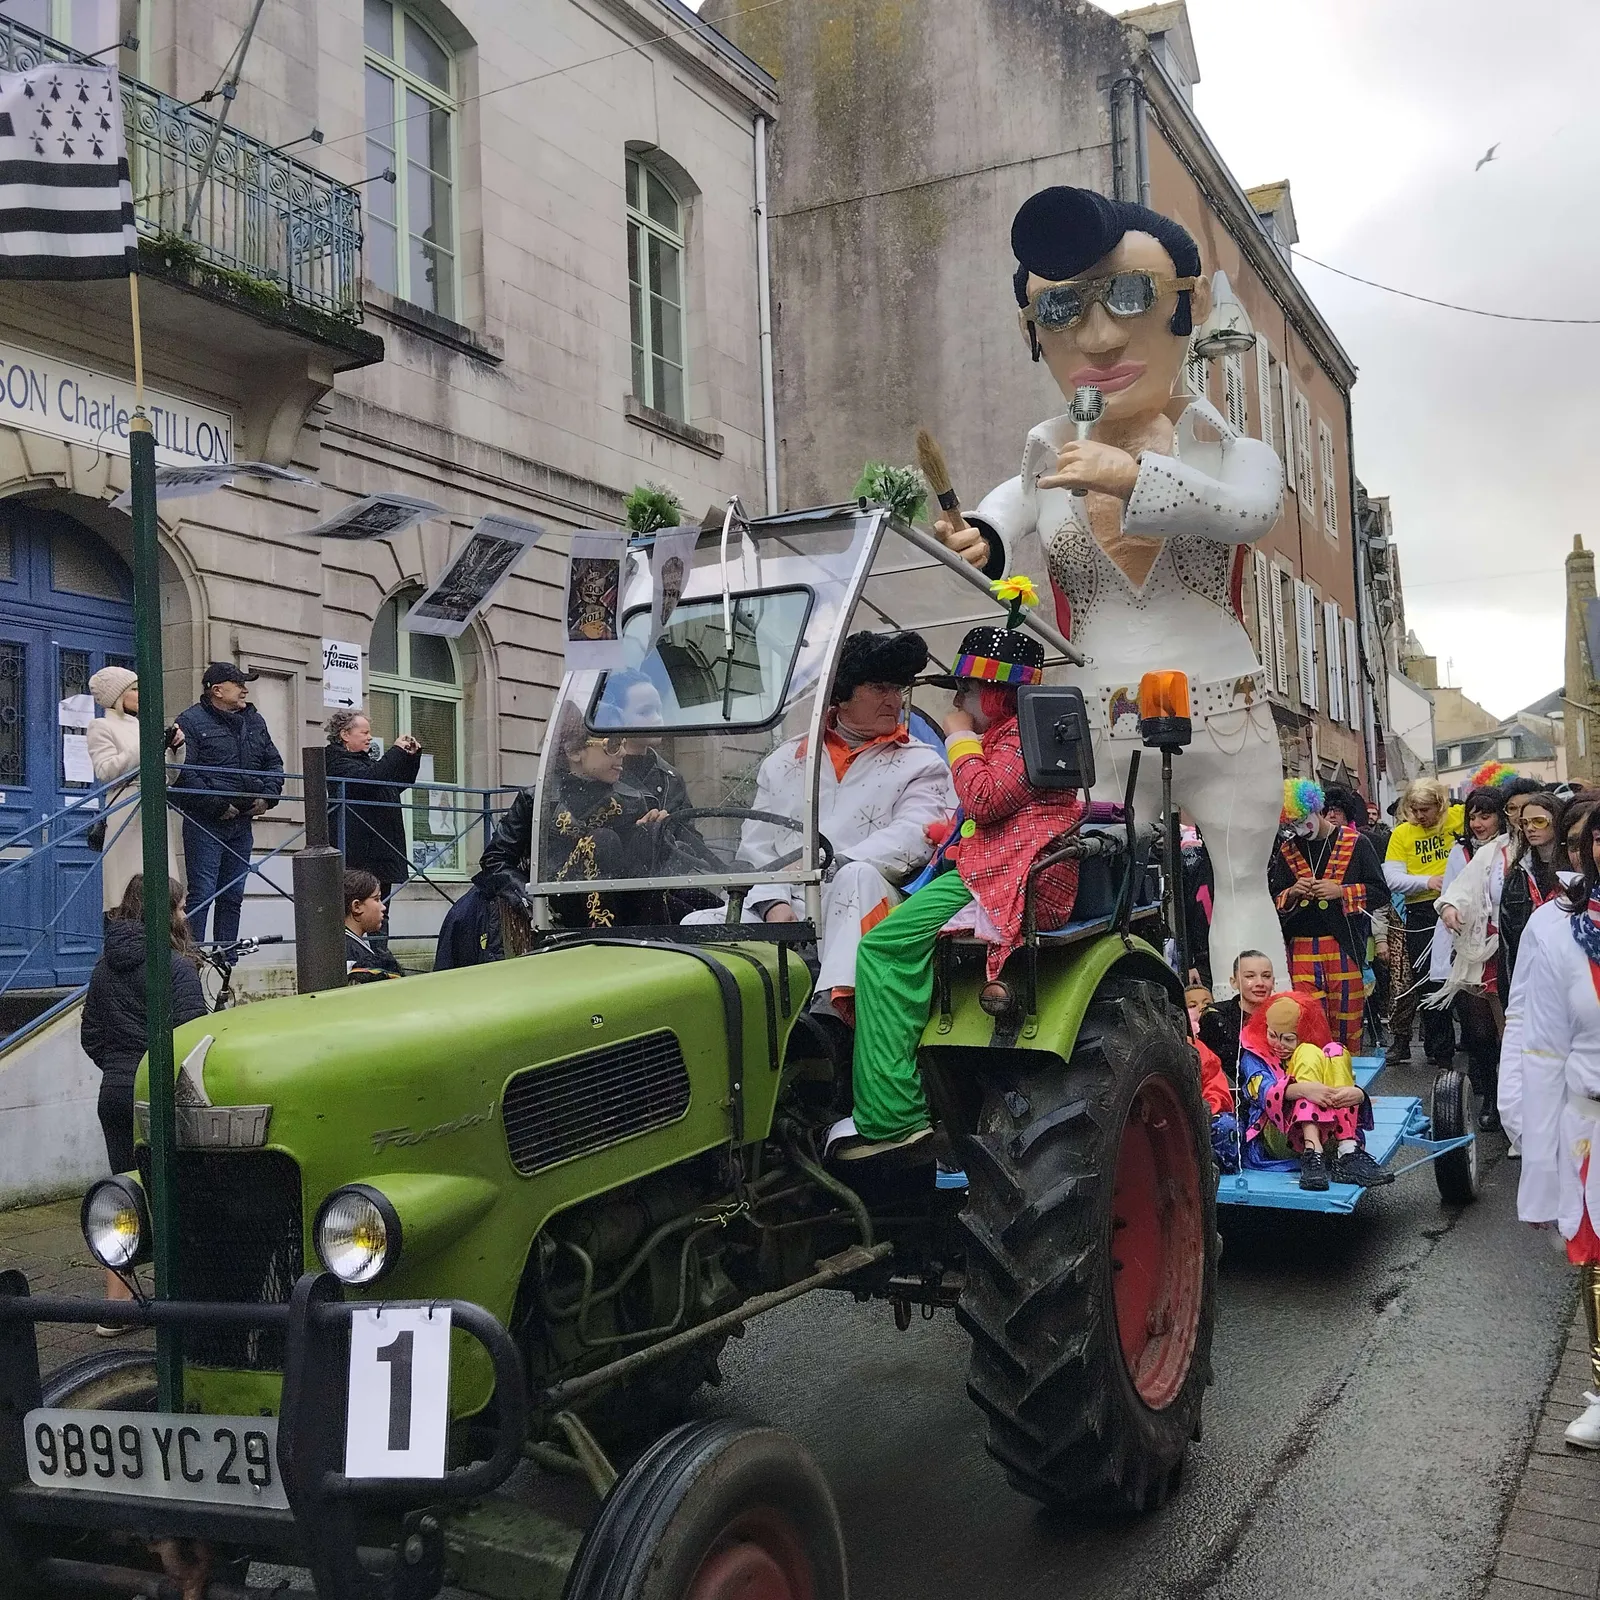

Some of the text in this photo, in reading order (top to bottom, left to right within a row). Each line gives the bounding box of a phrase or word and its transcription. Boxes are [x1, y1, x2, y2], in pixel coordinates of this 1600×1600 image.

[58, 379, 129, 439] Charle
[151, 406, 229, 464] TILLON
[1414, 833, 1445, 856] BRICE
[1421, 852, 1433, 864] de
[376, 1330, 415, 1451] 1
[34, 1422, 272, 1487] 9899 YC 29
